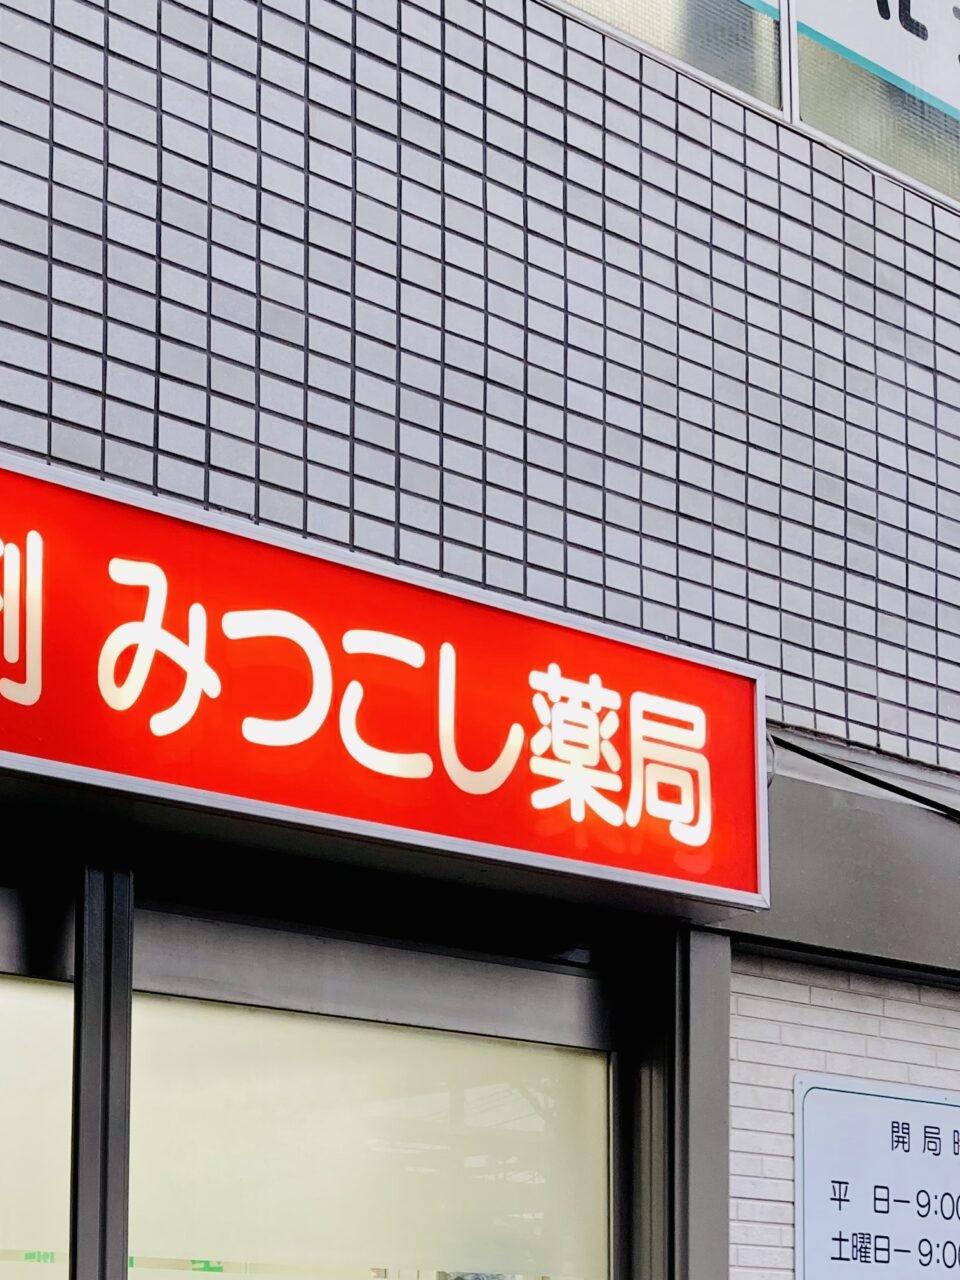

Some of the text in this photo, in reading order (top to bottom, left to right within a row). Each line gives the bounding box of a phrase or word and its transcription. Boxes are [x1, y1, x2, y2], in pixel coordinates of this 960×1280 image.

[97, 557, 712, 848] みつこし薬局
